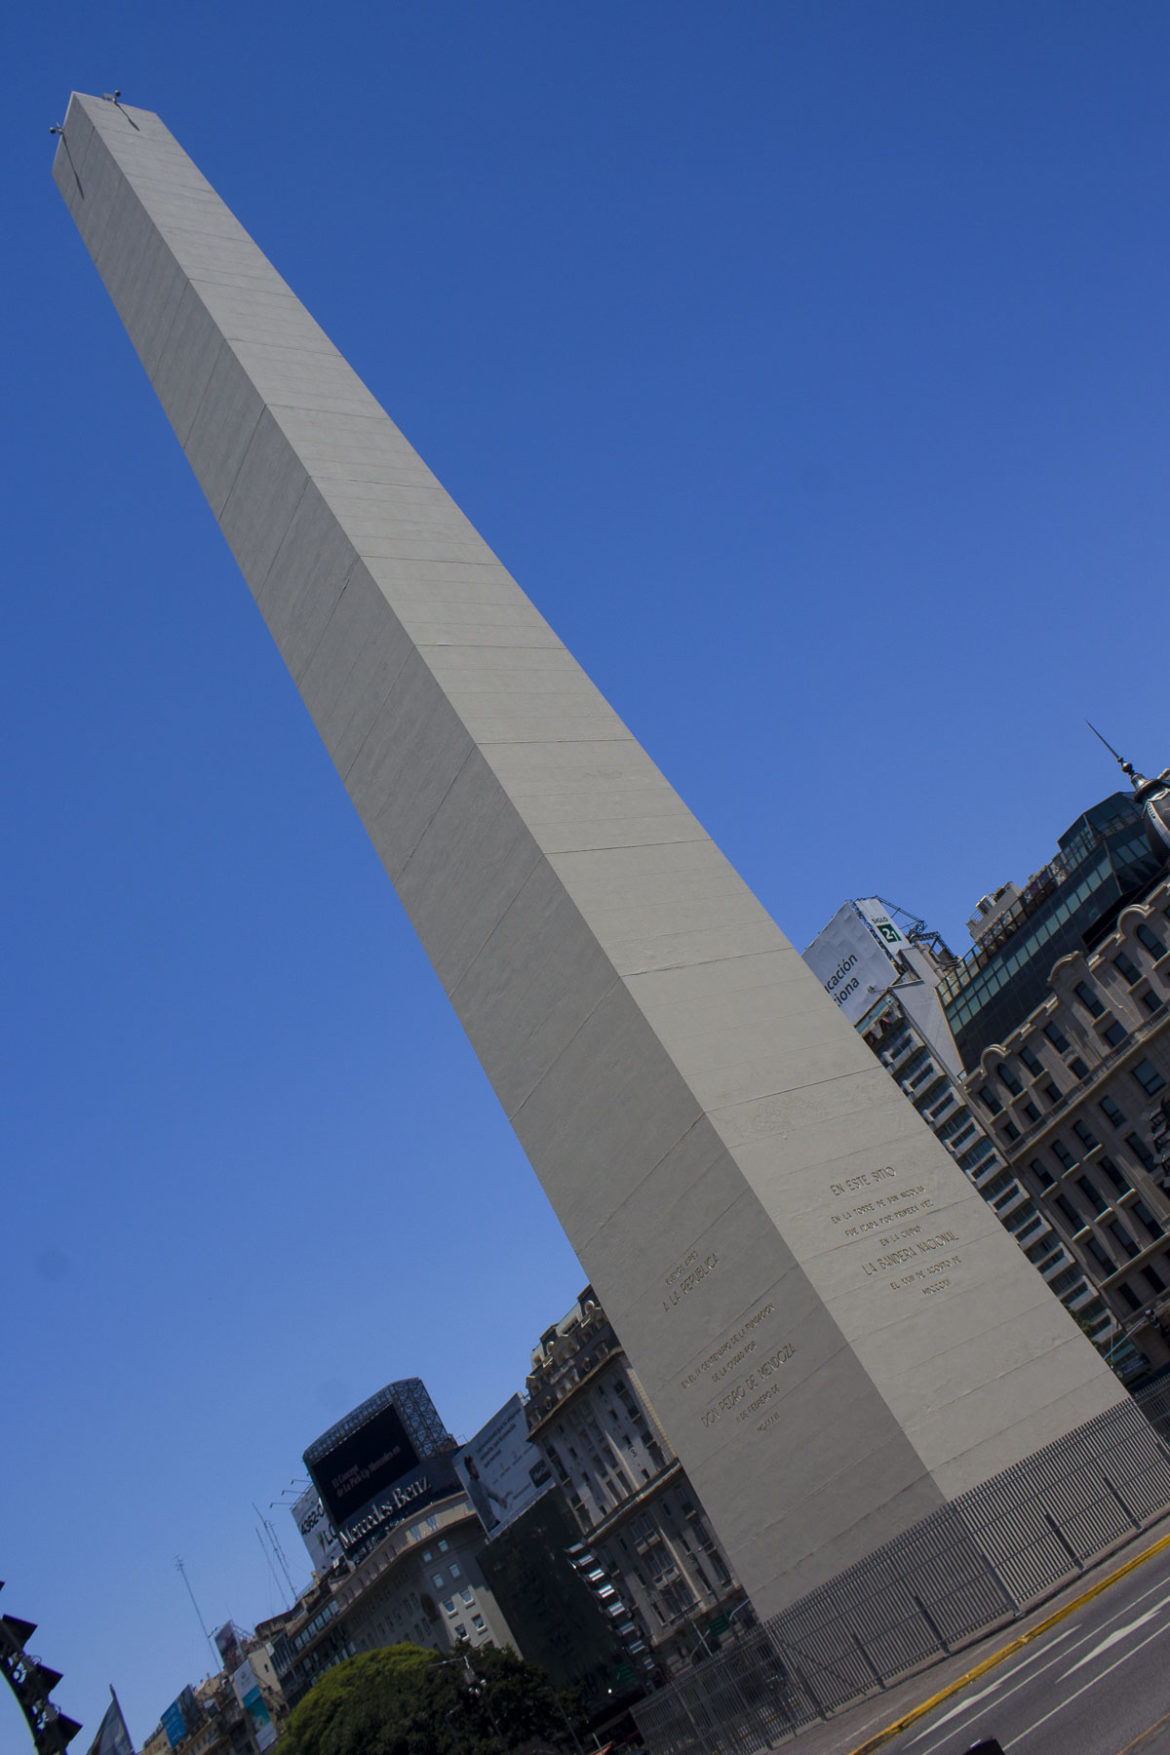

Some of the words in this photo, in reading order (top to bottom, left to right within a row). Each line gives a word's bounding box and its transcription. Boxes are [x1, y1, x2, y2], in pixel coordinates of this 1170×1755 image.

[830, 1184, 845, 1196] EN
[845, 1175, 871, 1191] ESTE
[871, 1166, 897, 1182] SITIO
[861, 1261, 878, 1276] LA
[877, 1246, 917, 1270] BANDERA
[917, 1231, 960, 1254] NACIONAL
[718, 1386, 746, 1410] PEDRO
[745, 1373, 760, 1391] DE
[757, 1343, 797, 1380] MENDOZA
